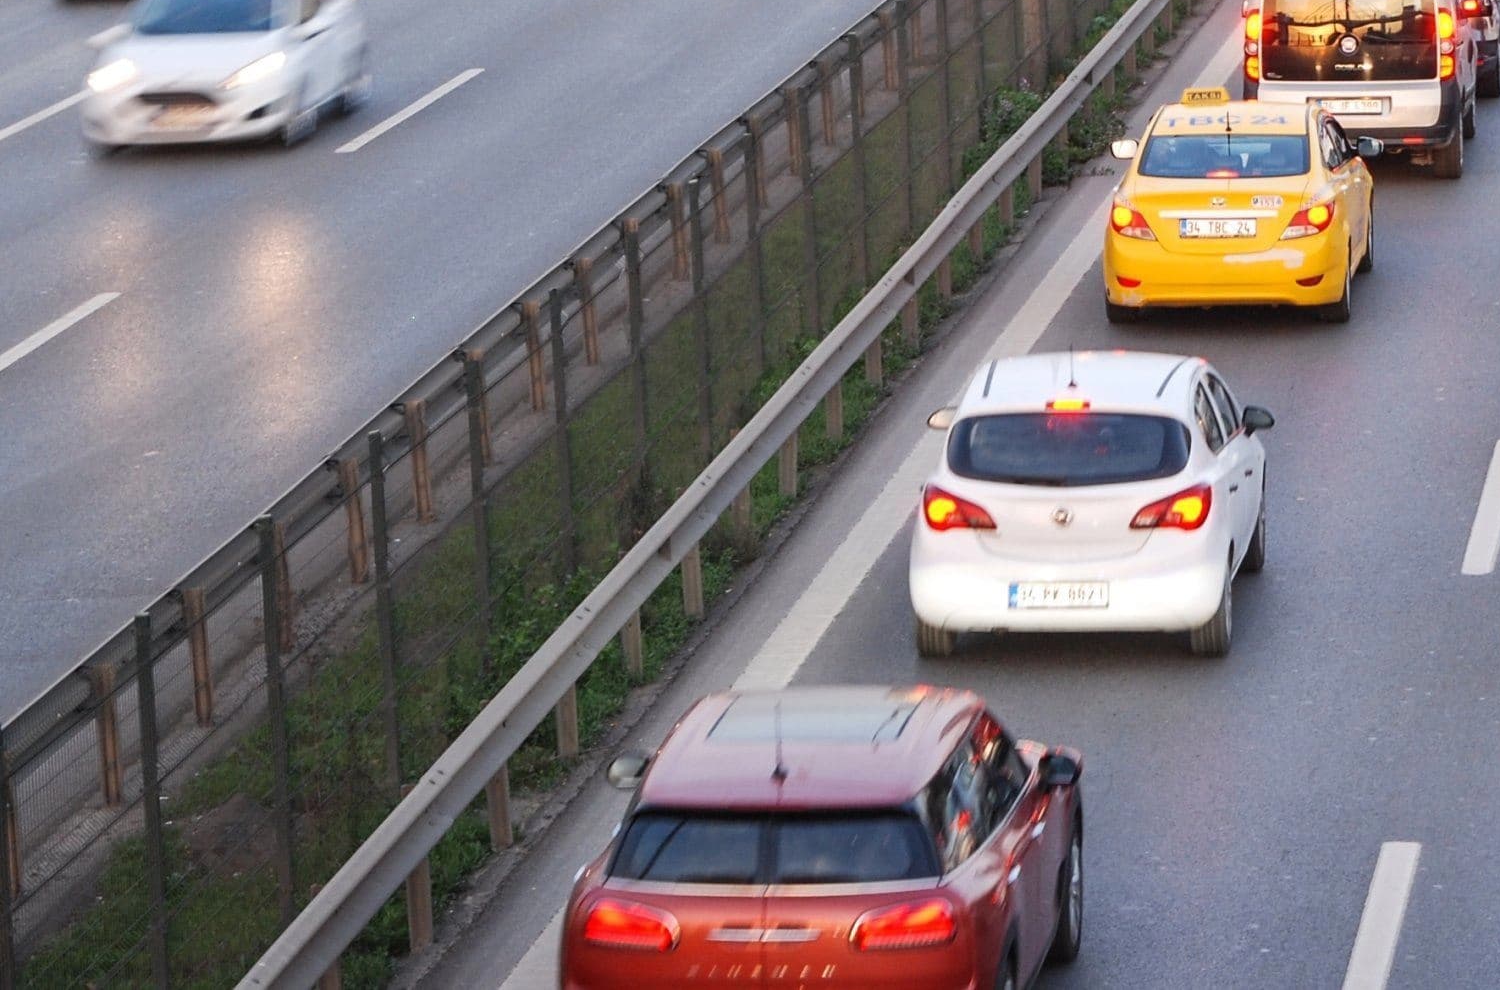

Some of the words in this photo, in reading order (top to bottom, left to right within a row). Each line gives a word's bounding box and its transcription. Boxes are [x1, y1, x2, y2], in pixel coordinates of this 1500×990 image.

[1188, 221, 1200, 234] 34
[1209, 221, 1228, 233] TBC
[1237, 221, 1250, 233] 24
